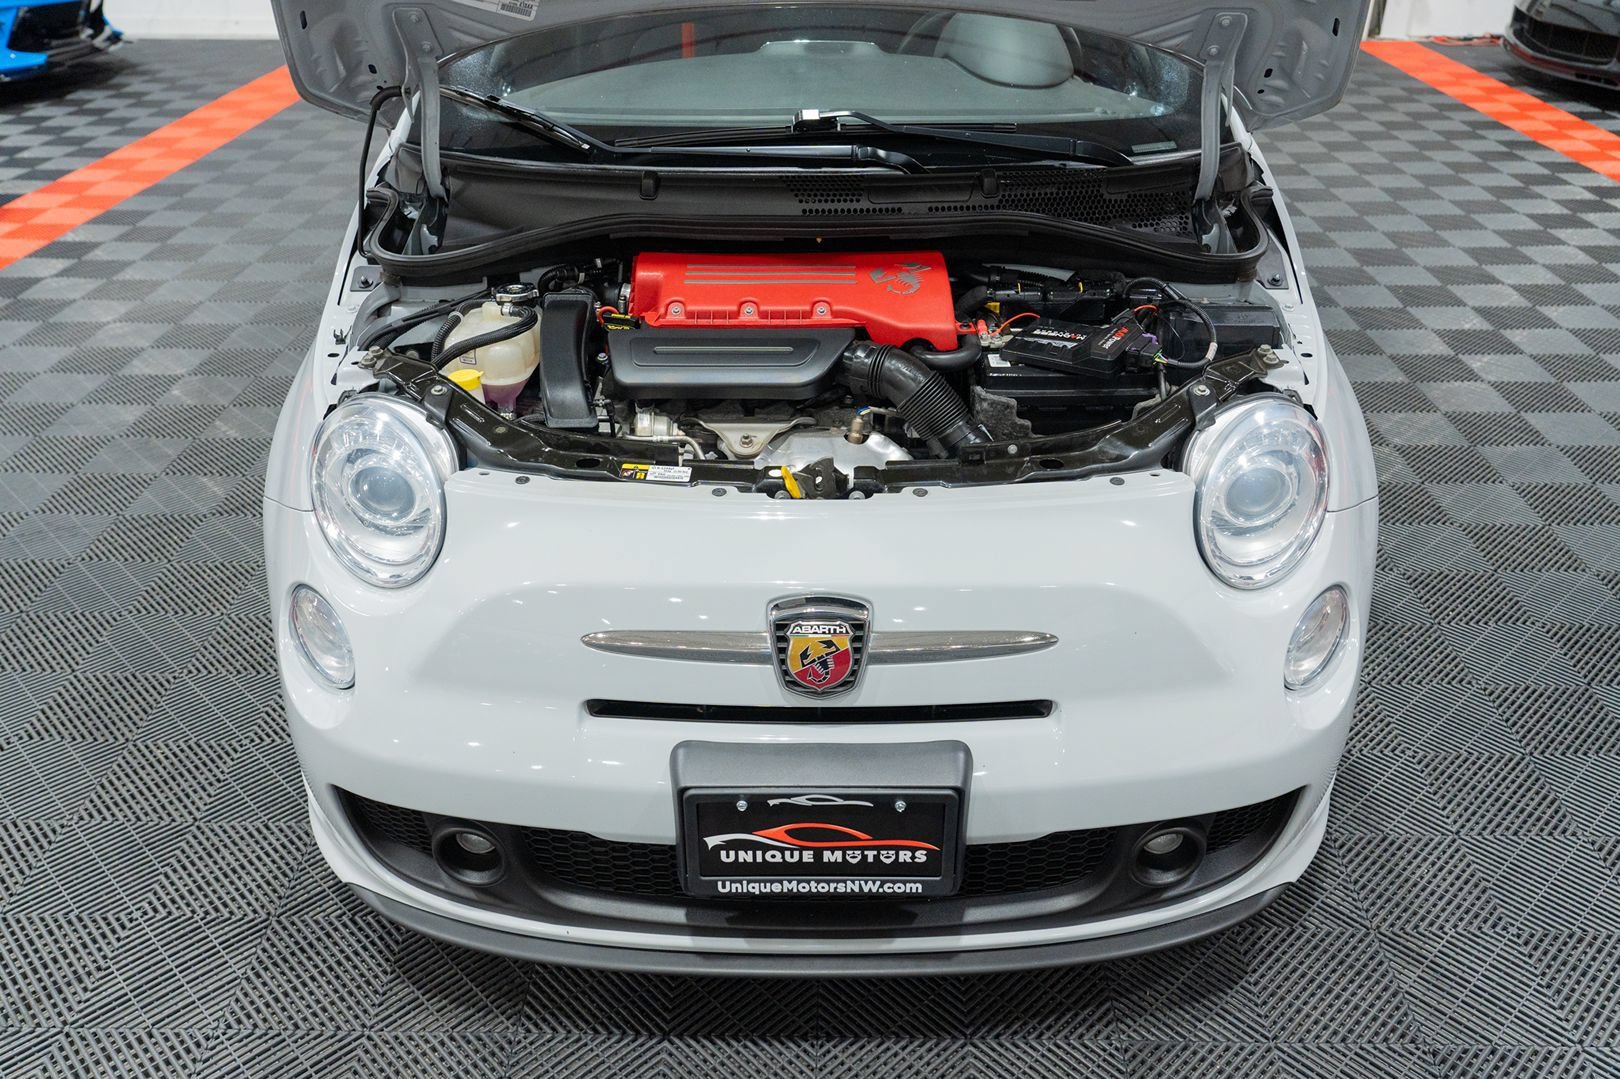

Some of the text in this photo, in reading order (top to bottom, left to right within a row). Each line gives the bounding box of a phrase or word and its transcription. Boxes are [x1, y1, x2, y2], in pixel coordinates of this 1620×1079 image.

[793, 625, 847, 634] ABARTH
[720, 850, 928, 865] UNIQUE MOTORS
[717, 880, 923, 895] UniqueMotorsNW.com
